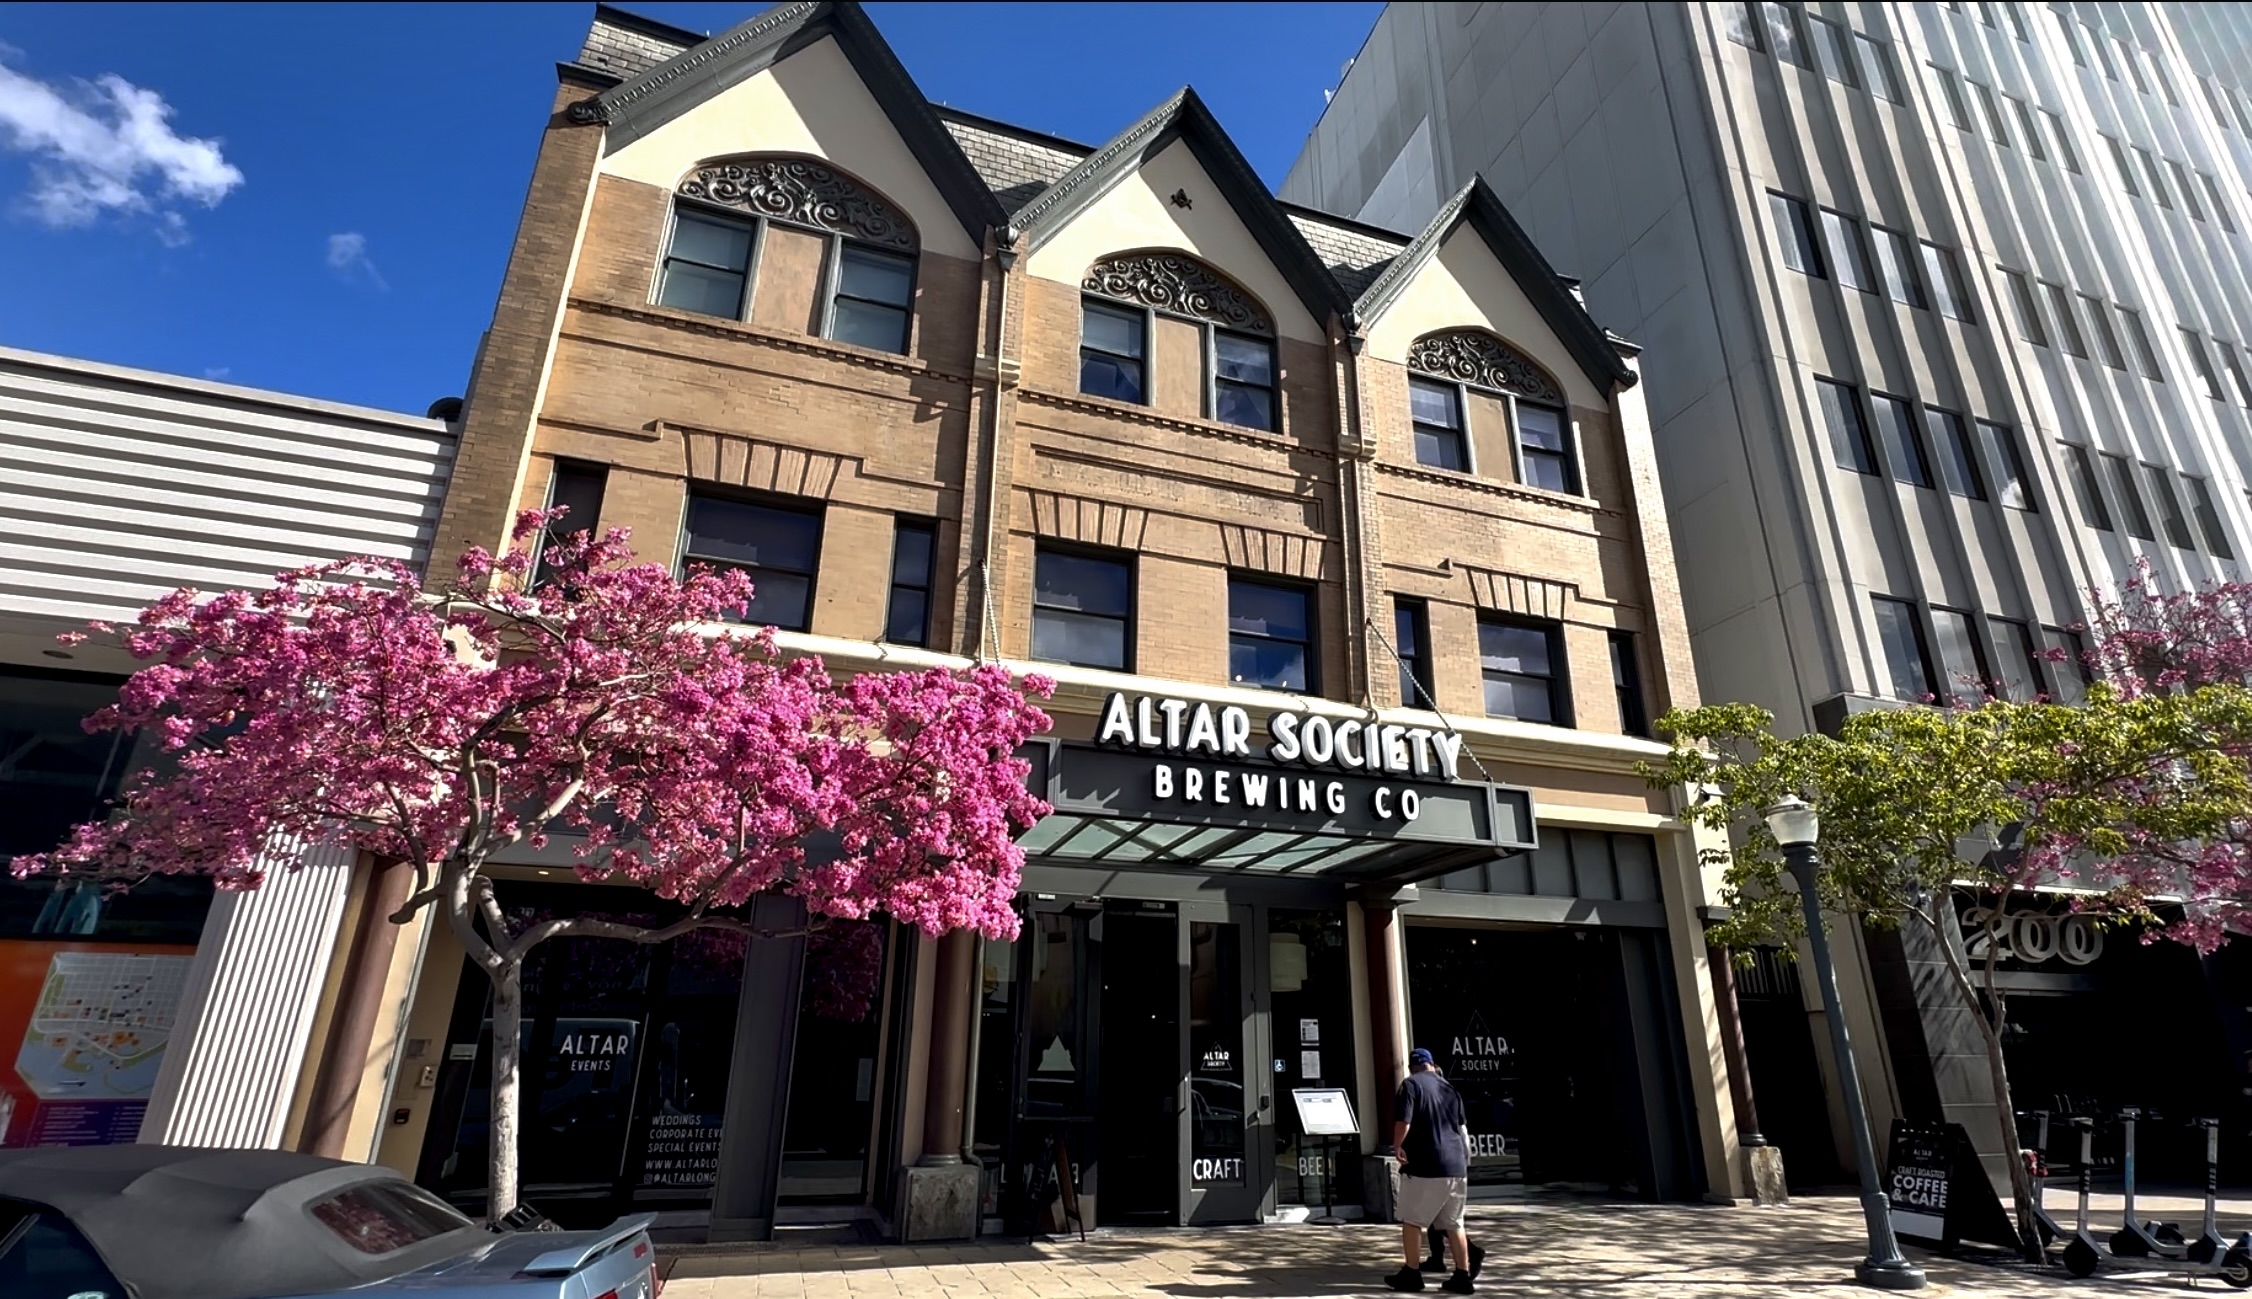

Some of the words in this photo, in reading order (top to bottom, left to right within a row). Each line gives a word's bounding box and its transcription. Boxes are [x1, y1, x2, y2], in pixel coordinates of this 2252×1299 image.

[1100, 692, 1250, 757] ALTAR
[1271, 711, 1462, 779] SOCIETY
[1156, 764, 1345, 814] BREWING
[1375, 786, 1419, 821] CO
[1961, 906, 2103, 966] 200
[559, 1034, 629, 1055] ALTAR
[1452, 1036, 1509, 1056] ALTAR
[570, 1060, 611, 1071] EVENTS
[1203, 1051, 1230, 1060] ALTAR
[1461, 1059, 1500, 1071] SOCIETY
[652, 1115, 702, 1126] WEDDINGS
[649, 1128, 706, 1139] CORPORATE
[647, 1142, 685, 1153] SPECIAL
[1469, 1133, 1506, 1157] BEER
[1193, 1158, 1241, 1180] CRAFT
[1893, 1175, 1948, 1195] COFFEE
[1891, 1188, 1902, 1202] &
[1909, 1190, 1946, 1209] CAFE
